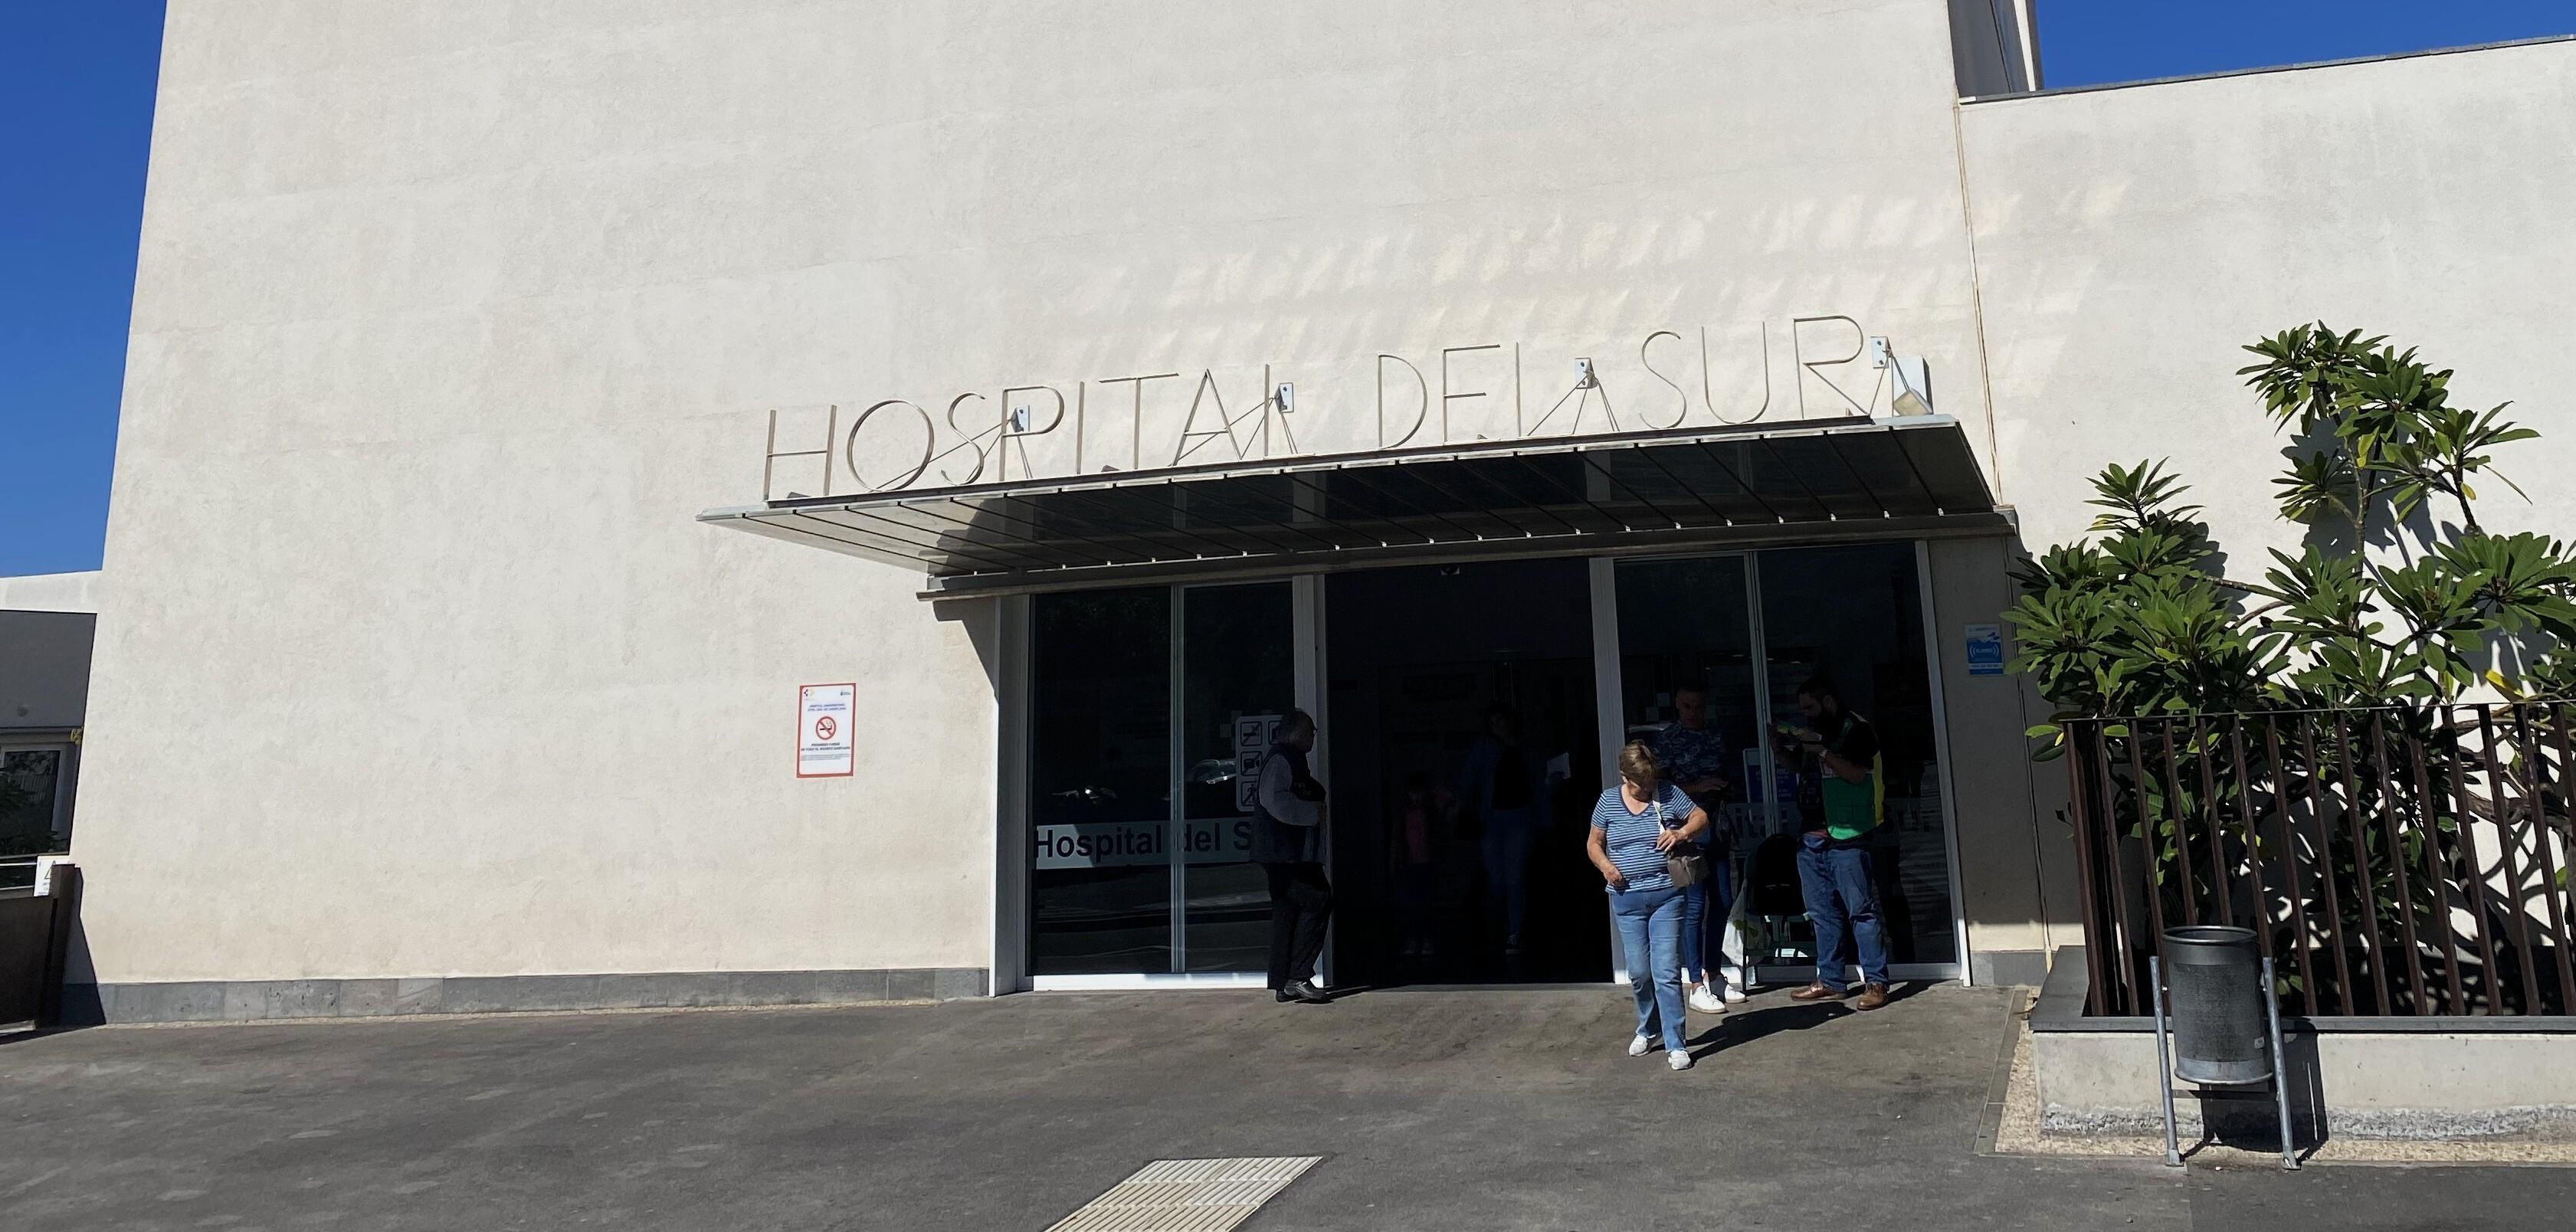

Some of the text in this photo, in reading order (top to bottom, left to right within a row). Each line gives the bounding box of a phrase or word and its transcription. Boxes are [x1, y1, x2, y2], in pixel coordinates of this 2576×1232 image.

[765, 315, 1870, 501] HOSPITAL DEL SUR
[1034, 824, 1162, 863] Hospital
